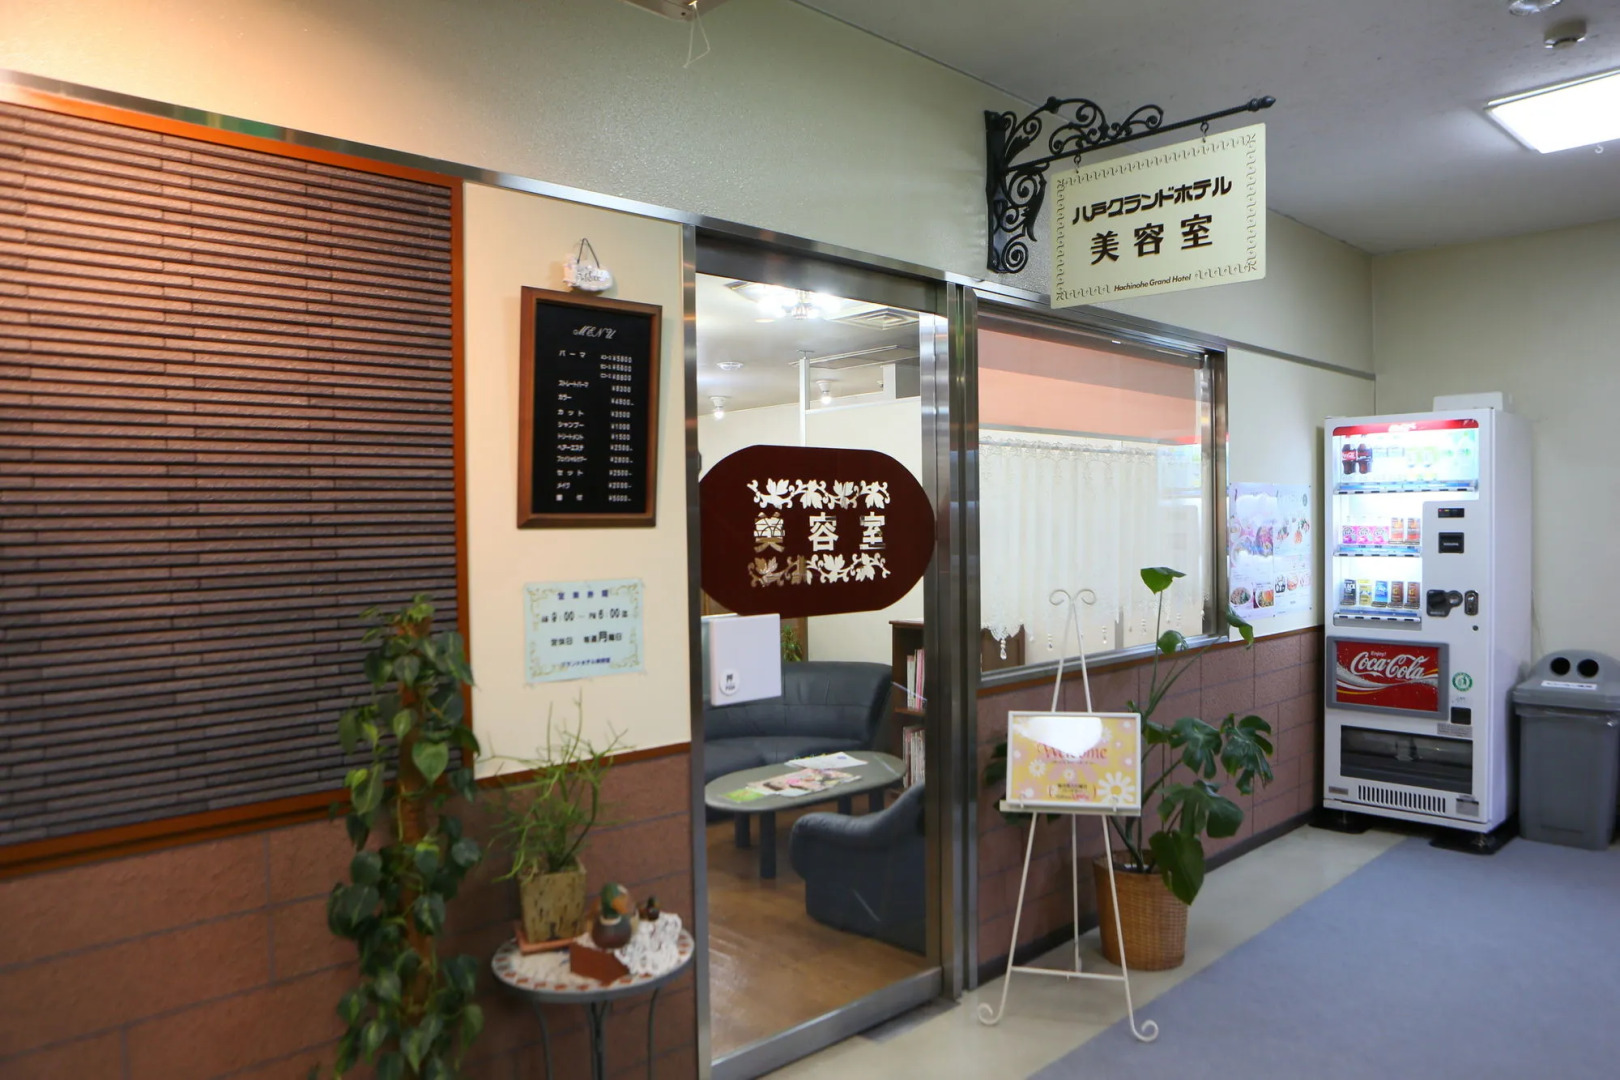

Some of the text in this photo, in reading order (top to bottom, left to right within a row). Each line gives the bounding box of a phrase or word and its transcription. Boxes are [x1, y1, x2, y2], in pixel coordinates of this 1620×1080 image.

[1090, 213, 1213, 266] 美容室
[1113, 273, 1192, 292] Hachinohe Grand Hotel
[573, 325, 616, 339] MENU
[753, 511, 886, 553] 美容室
[1350, 651, 1430, 680] Coca-Cola
